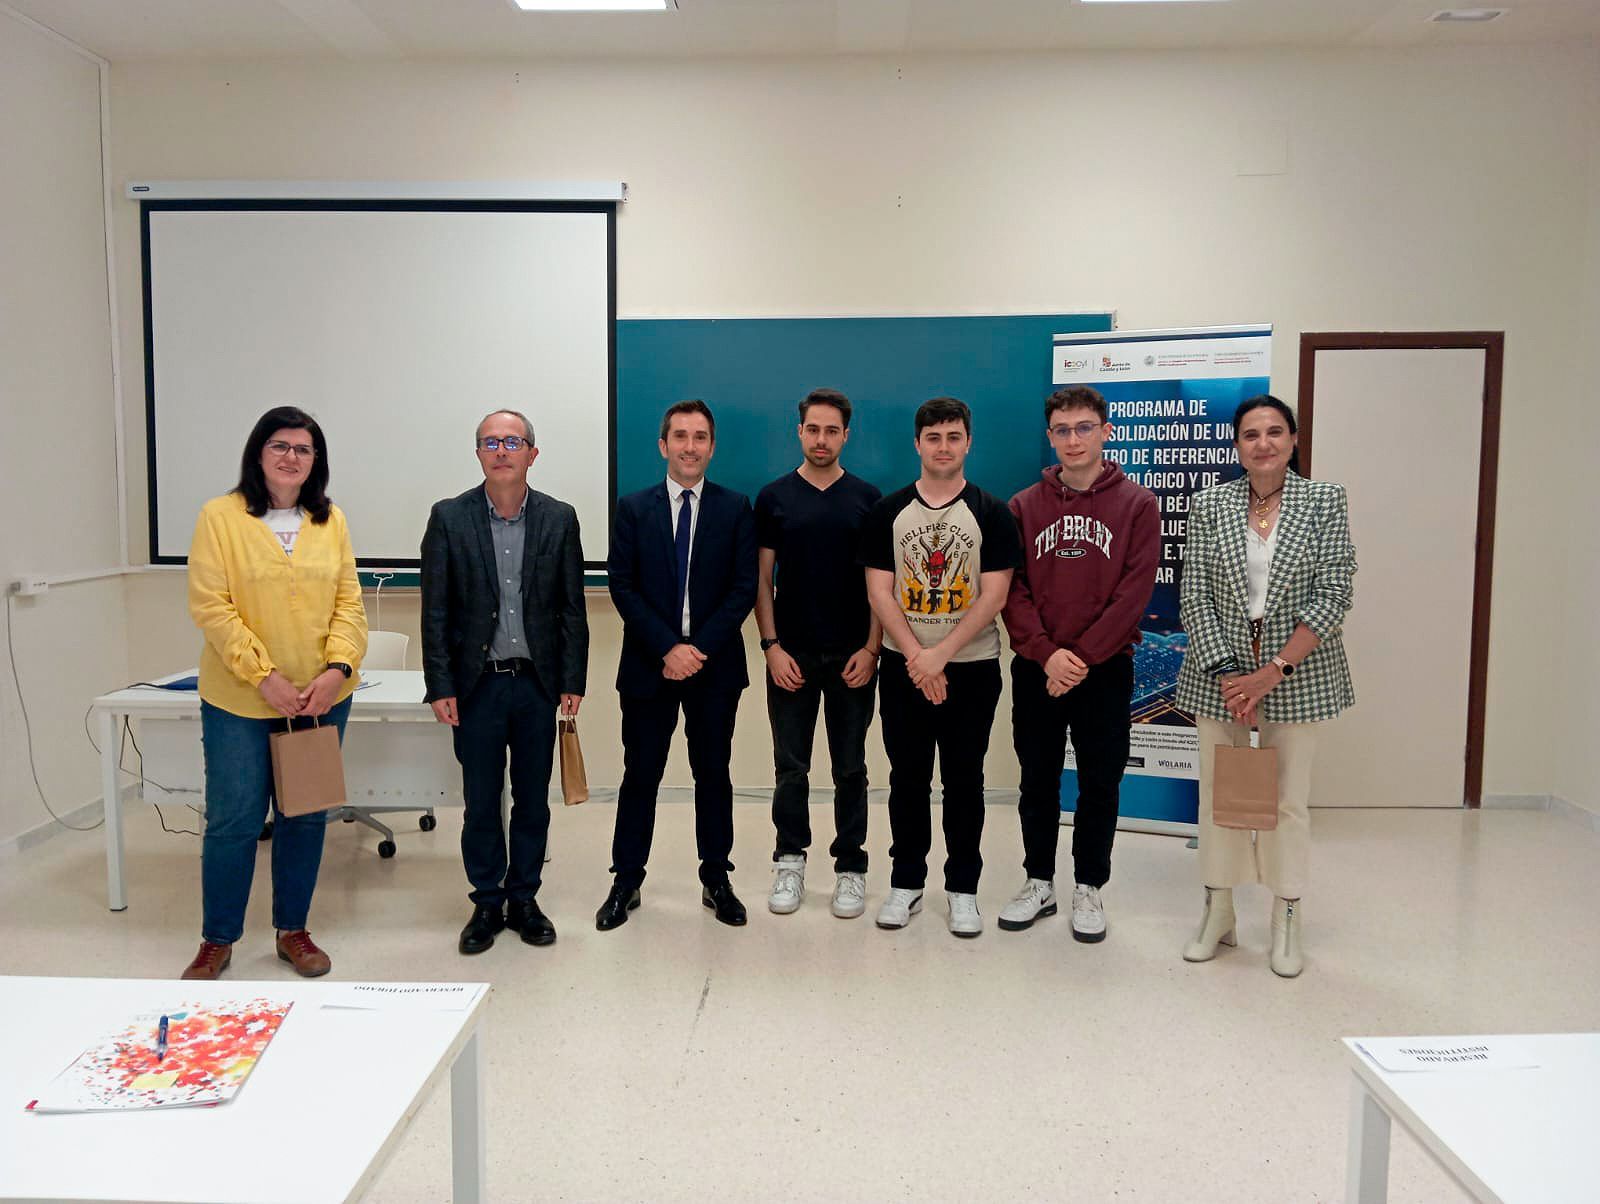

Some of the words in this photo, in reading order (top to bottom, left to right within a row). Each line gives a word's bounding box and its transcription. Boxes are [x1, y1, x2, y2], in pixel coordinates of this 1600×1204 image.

[1109, 400, 1185, 418] PROGRAMA
[1189, 399, 1208, 416] DE
[1108, 421, 1189, 441] SOLIDACIÓN
[1193, 423, 1212, 440] DE
[1102, 448, 1128, 465] TRO
[1132, 448, 1150, 465] DE
[1153, 447, 1240, 465] REFERENCIA
[1127, 469, 1185, 489] OLÓGICO
[1188, 472, 1199, 488] Y
[1202, 472, 1221, 488] DE
[1166, 493, 1190, 513] BÉJ
[900, 522, 948, 549] HELLFIRE
[949, 524, 975, 549] CLUB
[1160, 519, 1187, 536] LUE
[1164, 543, 1186, 560] E.T
[1155, 567, 1174, 584] AR
[907, 616, 941, 625] RANGER
